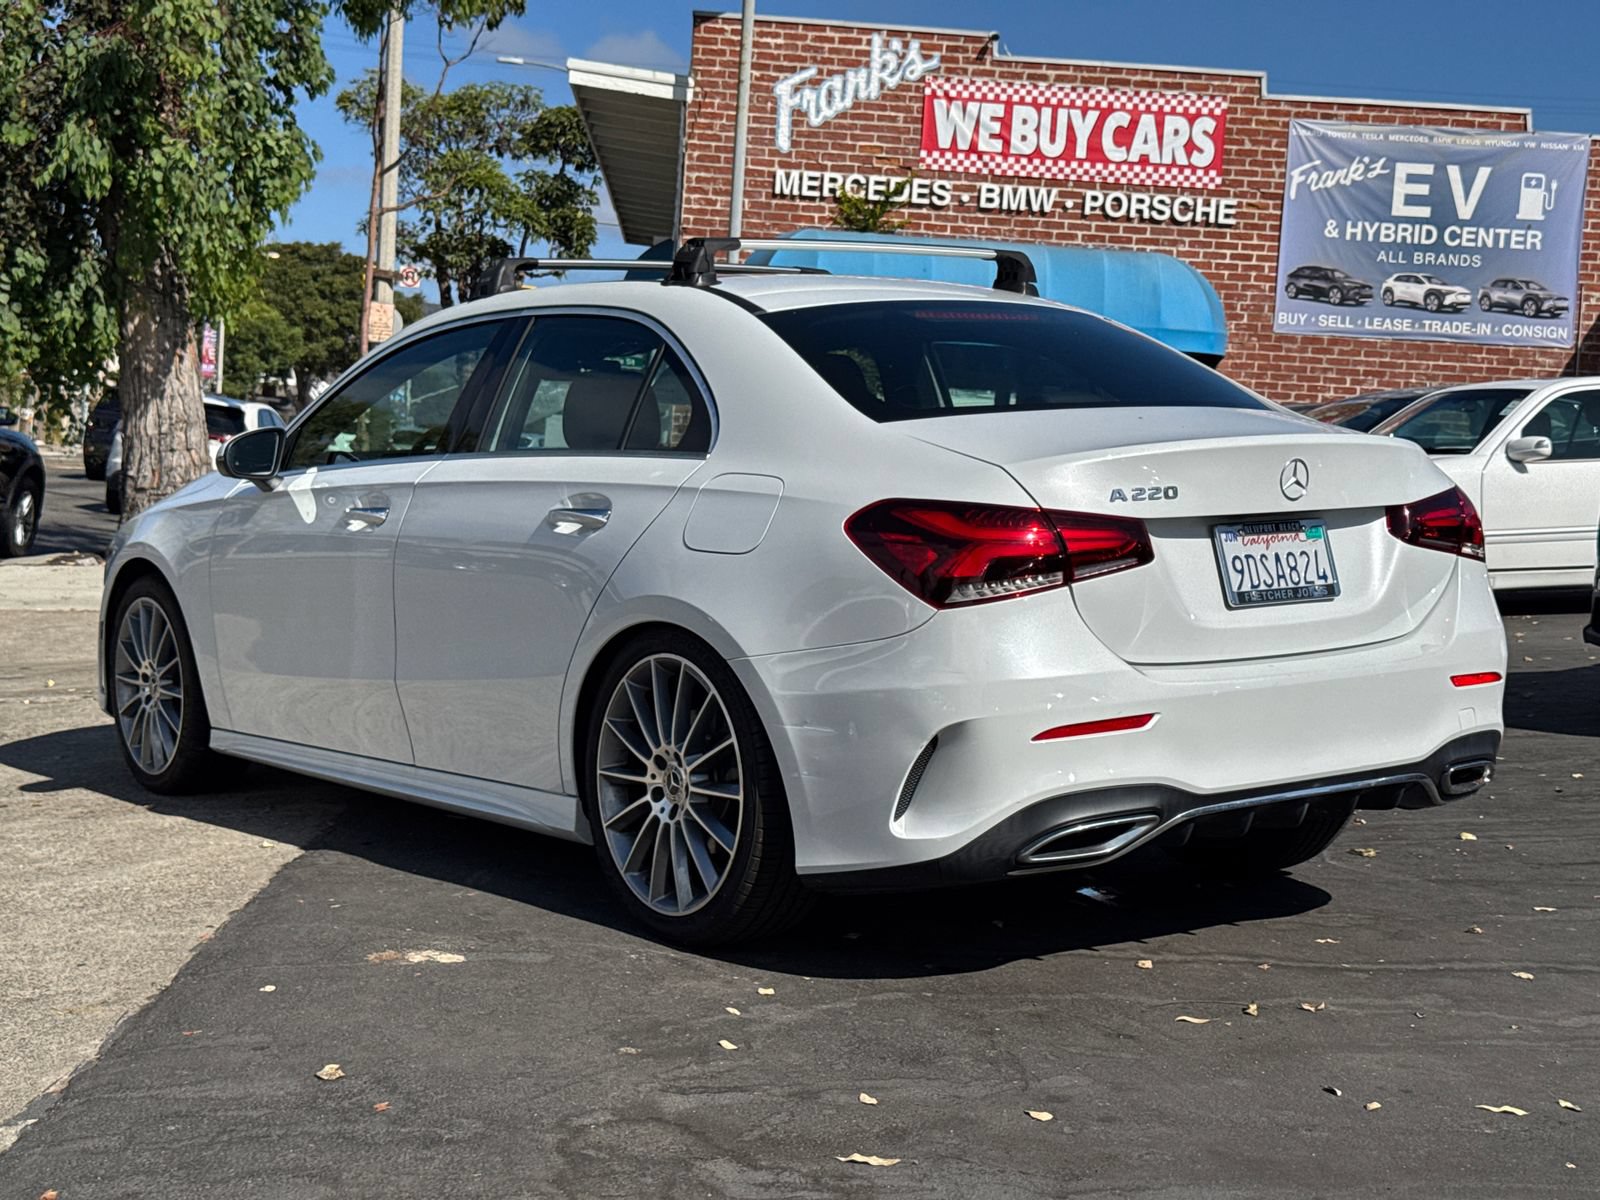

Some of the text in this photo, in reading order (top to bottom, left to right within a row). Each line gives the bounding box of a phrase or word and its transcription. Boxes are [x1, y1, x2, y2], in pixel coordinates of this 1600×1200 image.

[773, 32, 941, 153] Frank's
[933, 99, 1217, 168] WE BUY CARS
[1328, 130, 1357, 139] TOYOTA
[1361, 132, 1384, 141] TESLA
[1388, 134, 1429, 143] MERCEDES
[1485, 139, 1520, 148] HYUNDAI
[1524, 141, 1537, 149] VW
[1541, 142, 1569, 151] NISSAN
[1573, 143, 1585, 151] KIA
[774, 169, 1238, 225] MERCEDES BMW PORSCHE
[1290, 156, 1493, 220] Frank's EV
[1324, 219, 1542, 251] & HYBRID CENTER
[1376, 250, 1482, 268] ALL BRANDS
[1278, 312, 1568, 339] BUY SELL LEASE TRADE-IN CONSIGN
[1110, 486, 1178, 502] A 220
[1241, 532, 1301, 551] California
[1231, 549, 1328, 591] 9DSA824
[1244, 588, 1294, 602] FLETCHER
